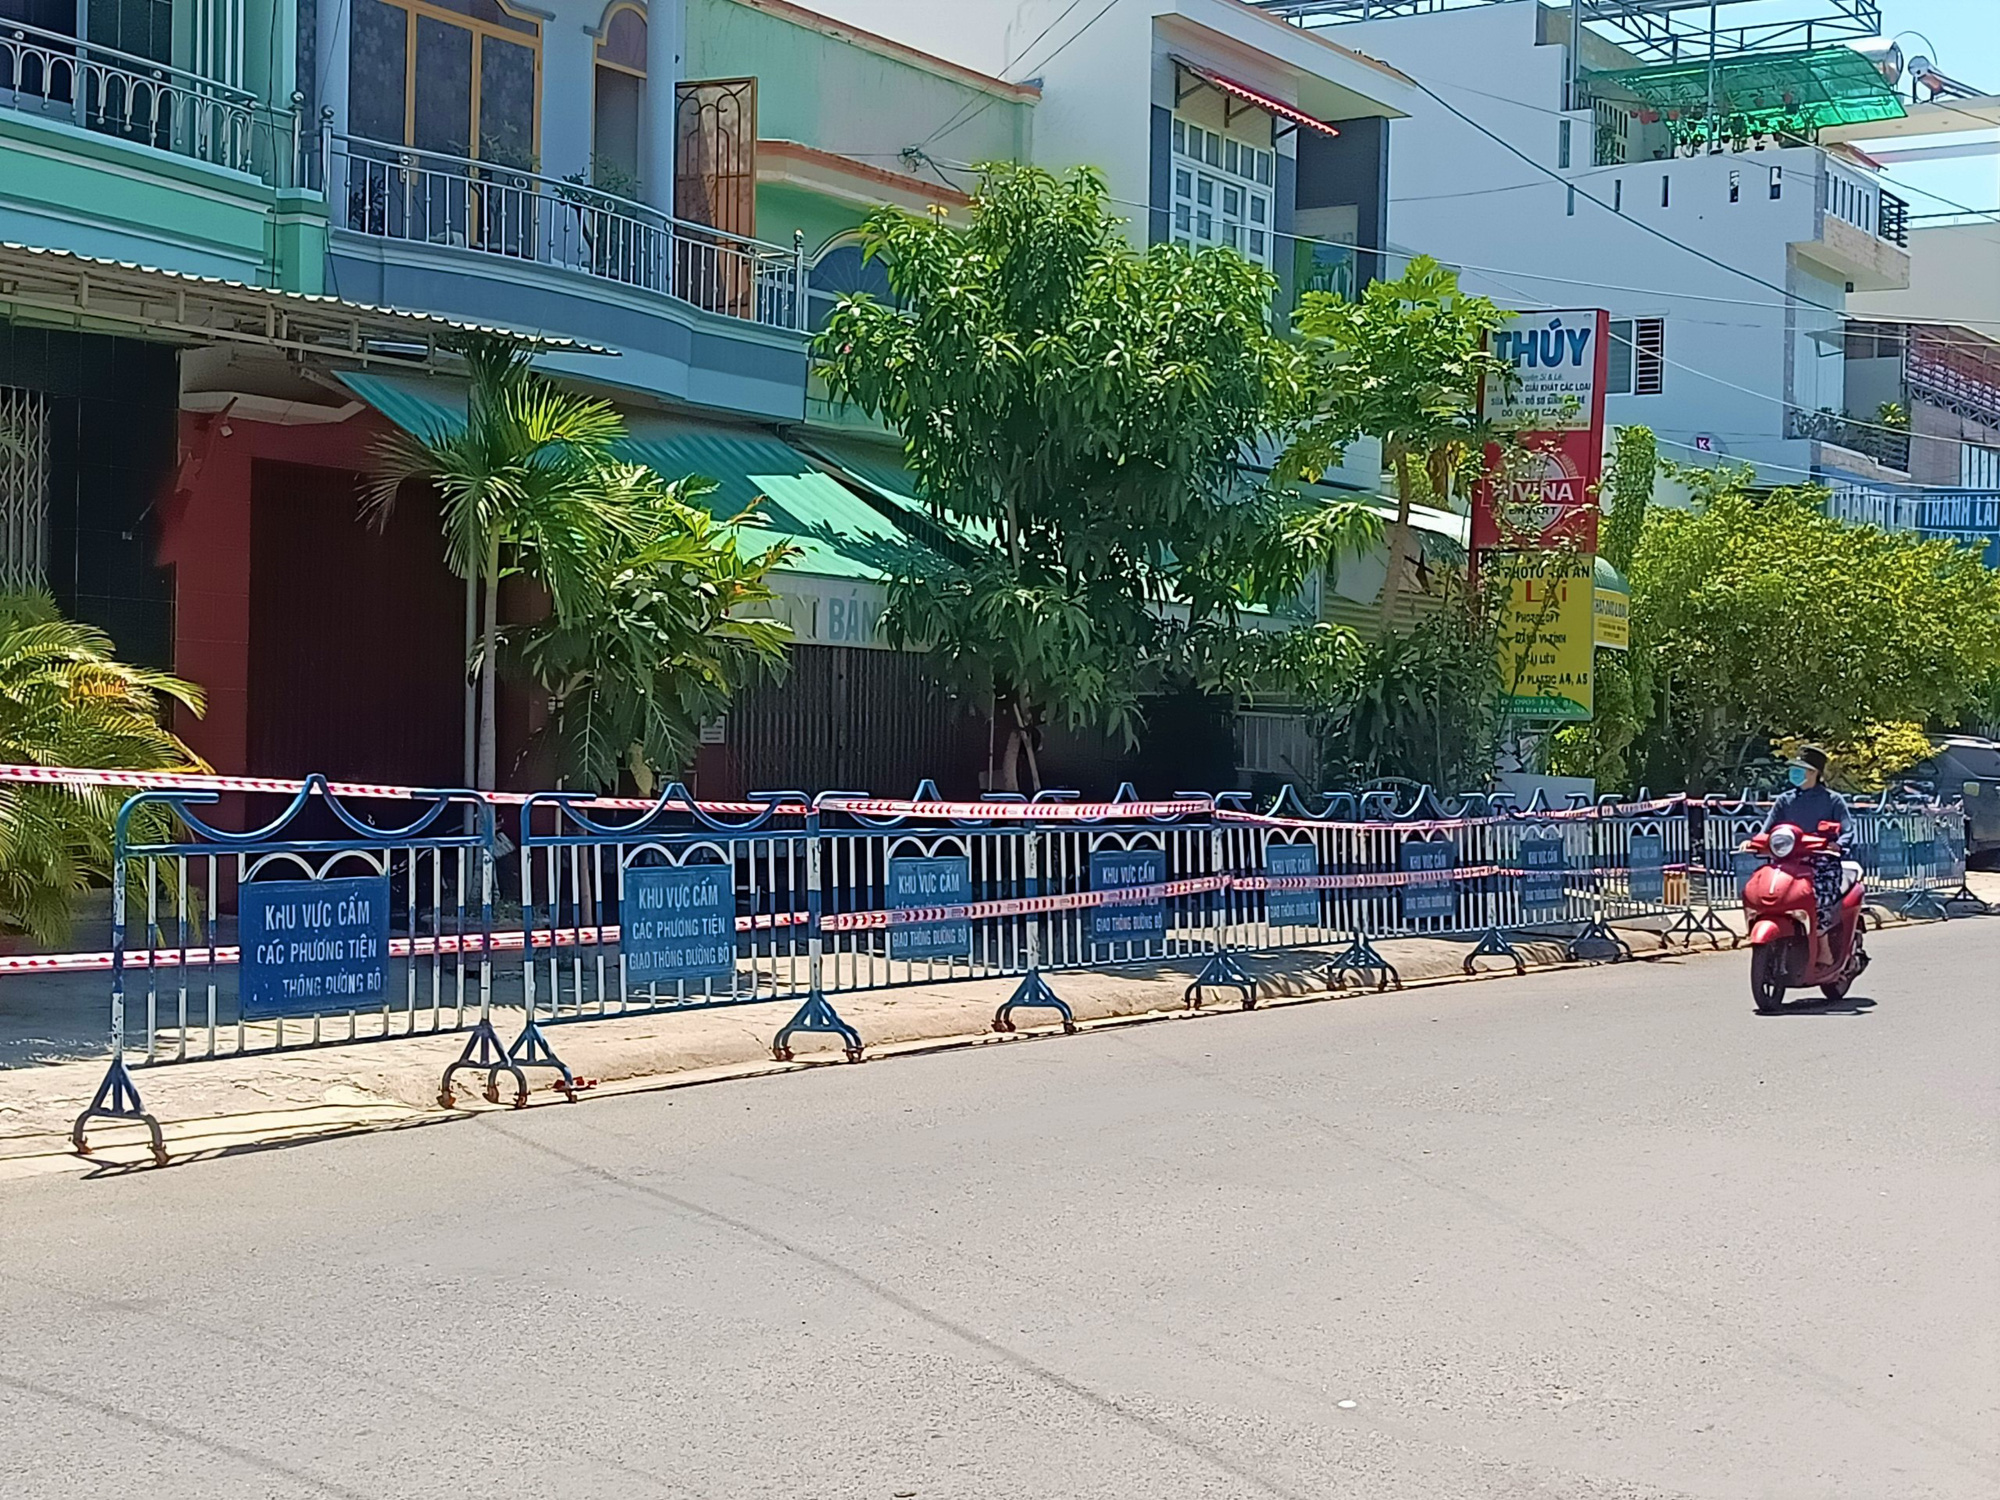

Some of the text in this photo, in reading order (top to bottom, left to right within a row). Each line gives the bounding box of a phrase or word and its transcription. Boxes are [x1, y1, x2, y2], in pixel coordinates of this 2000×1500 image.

[1492, 317, 1591, 368] THÚY
[639, 877, 718, 912] KHU VỰC CẤM
[898, 875, 916, 894] KHU
[265, 891, 370, 933] KHU VỰC CẤM
[632, 913, 725, 940] CÁC PHƯƠNG TIỆN
[257, 933, 377, 965] CÁC PHƯƠNG TIỆN
[629, 941, 730, 970] GIAO THÔNG ĐƯỜNG BỘ
[282, 973, 321, 998] THÔNG
